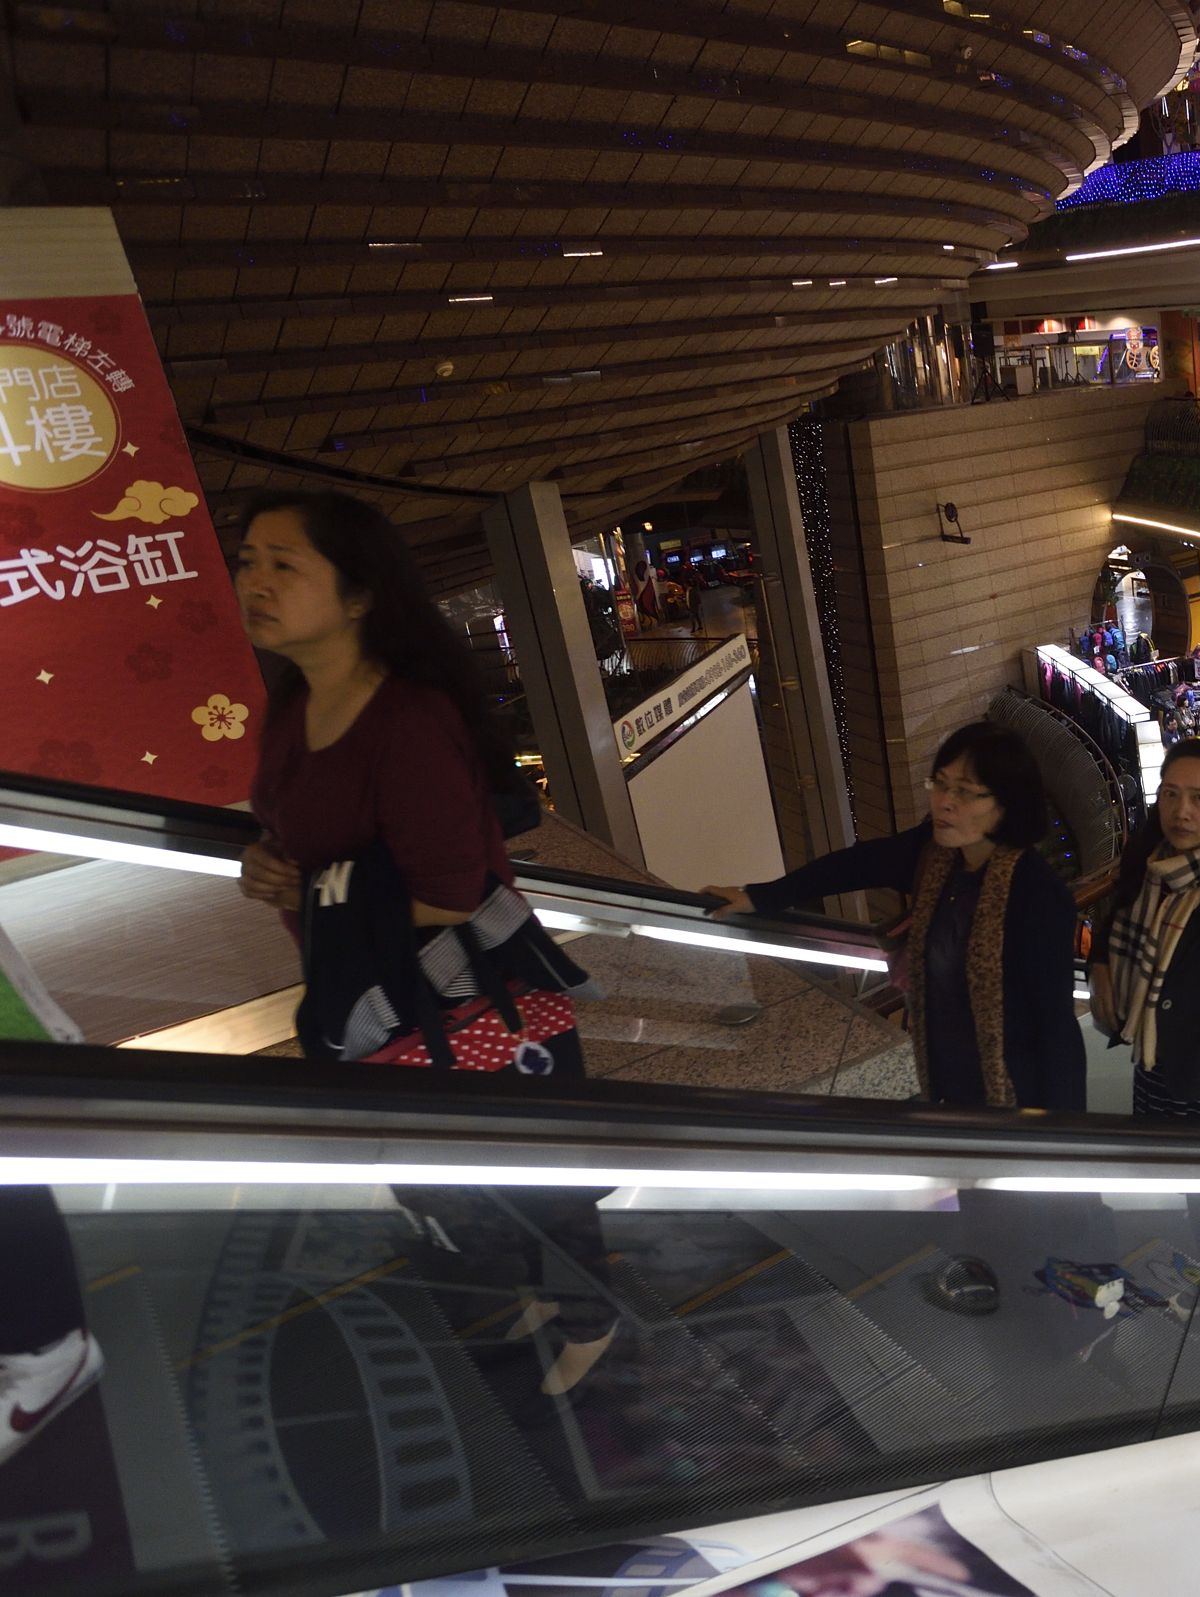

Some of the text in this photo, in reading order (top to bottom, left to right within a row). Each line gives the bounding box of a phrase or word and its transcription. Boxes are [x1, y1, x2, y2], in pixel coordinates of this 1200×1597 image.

[0, 313, 135, 393] 號電梯左轉
